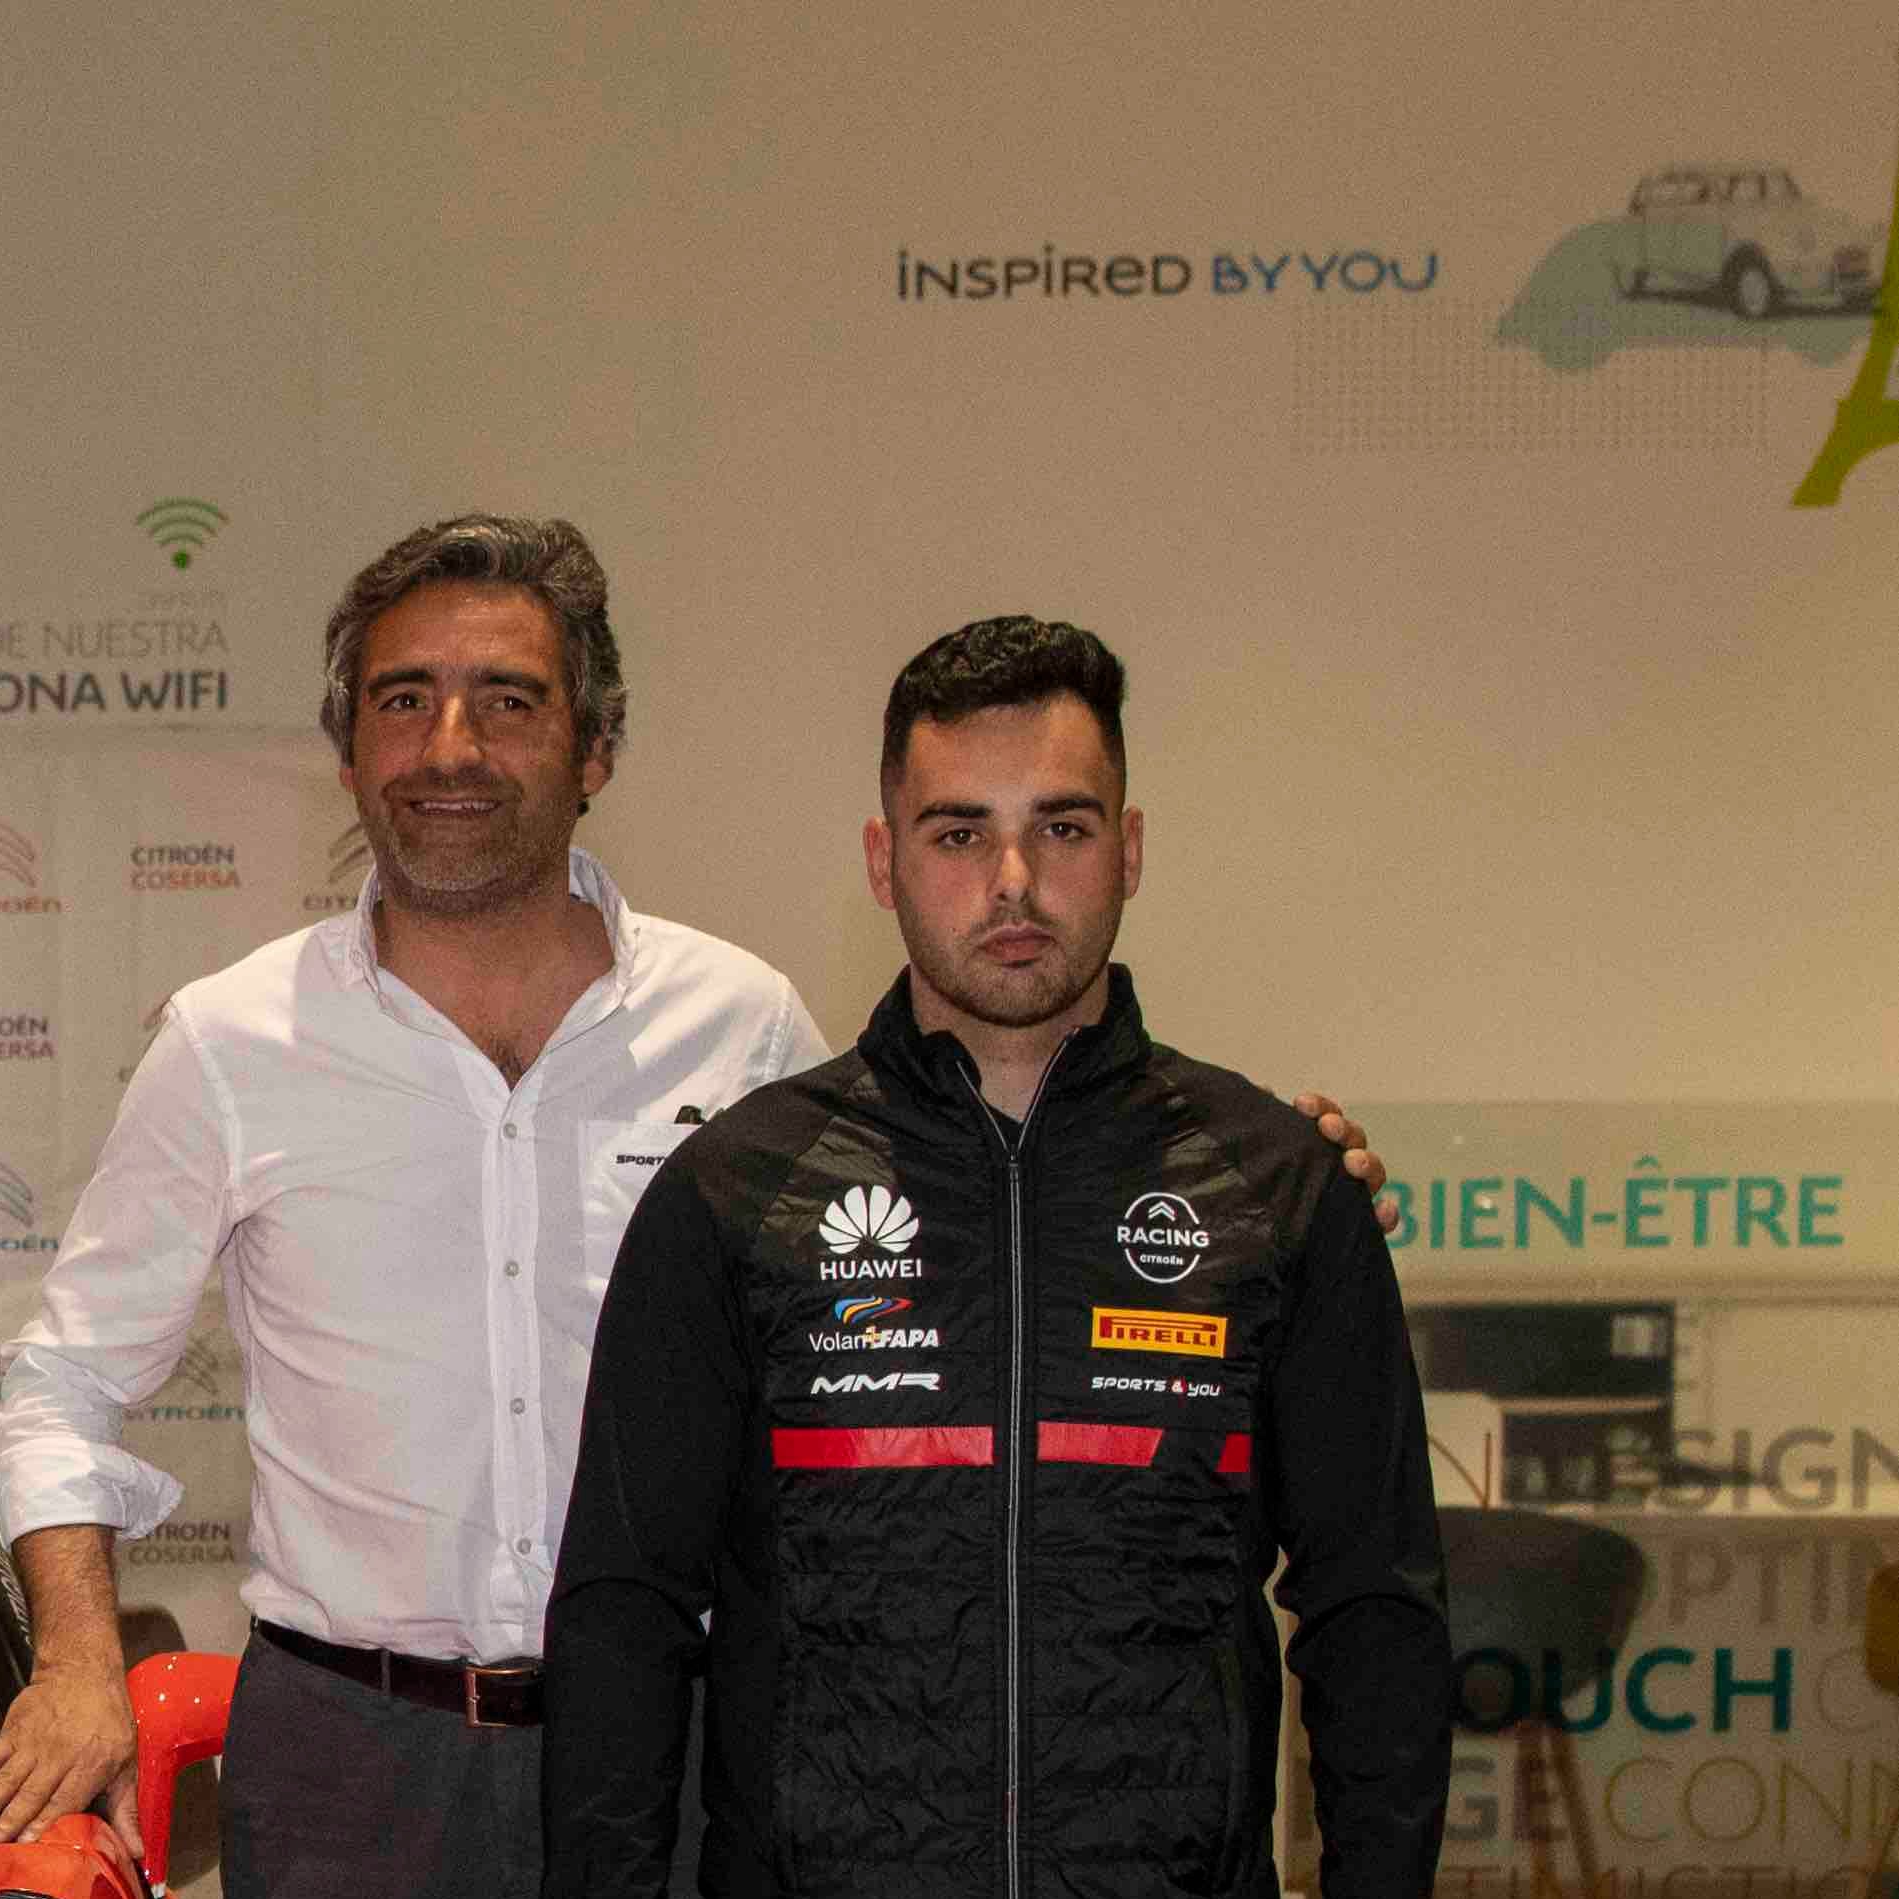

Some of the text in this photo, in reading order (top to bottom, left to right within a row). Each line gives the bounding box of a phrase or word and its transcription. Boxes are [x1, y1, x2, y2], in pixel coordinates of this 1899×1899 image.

[1212, 252, 1290, 297] BY
[1301, 251, 1439, 295] YOU
[41, 618, 231, 660] NUESTRA
[120, 669, 228, 711] WIFI
[130, 842, 236, 866] CITROËN
[131, 869, 240, 891] COSERSA
[616, 1153, 666, 1166] SPORT
[1116, 1226, 1210, 1248] RACING
[819, 1259, 923, 1282] HUAWEI
[1099, 1314, 1220, 1348] PIRELLI
[810, 1372, 942, 1396] MMR
[1091, 1376, 1167, 1393] SPORTS
[1187, 1382, 1221, 1398] YOU
[129, 1544, 235, 1565] COSERSA
[1450, 1646, 1794, 1734] OUCH
